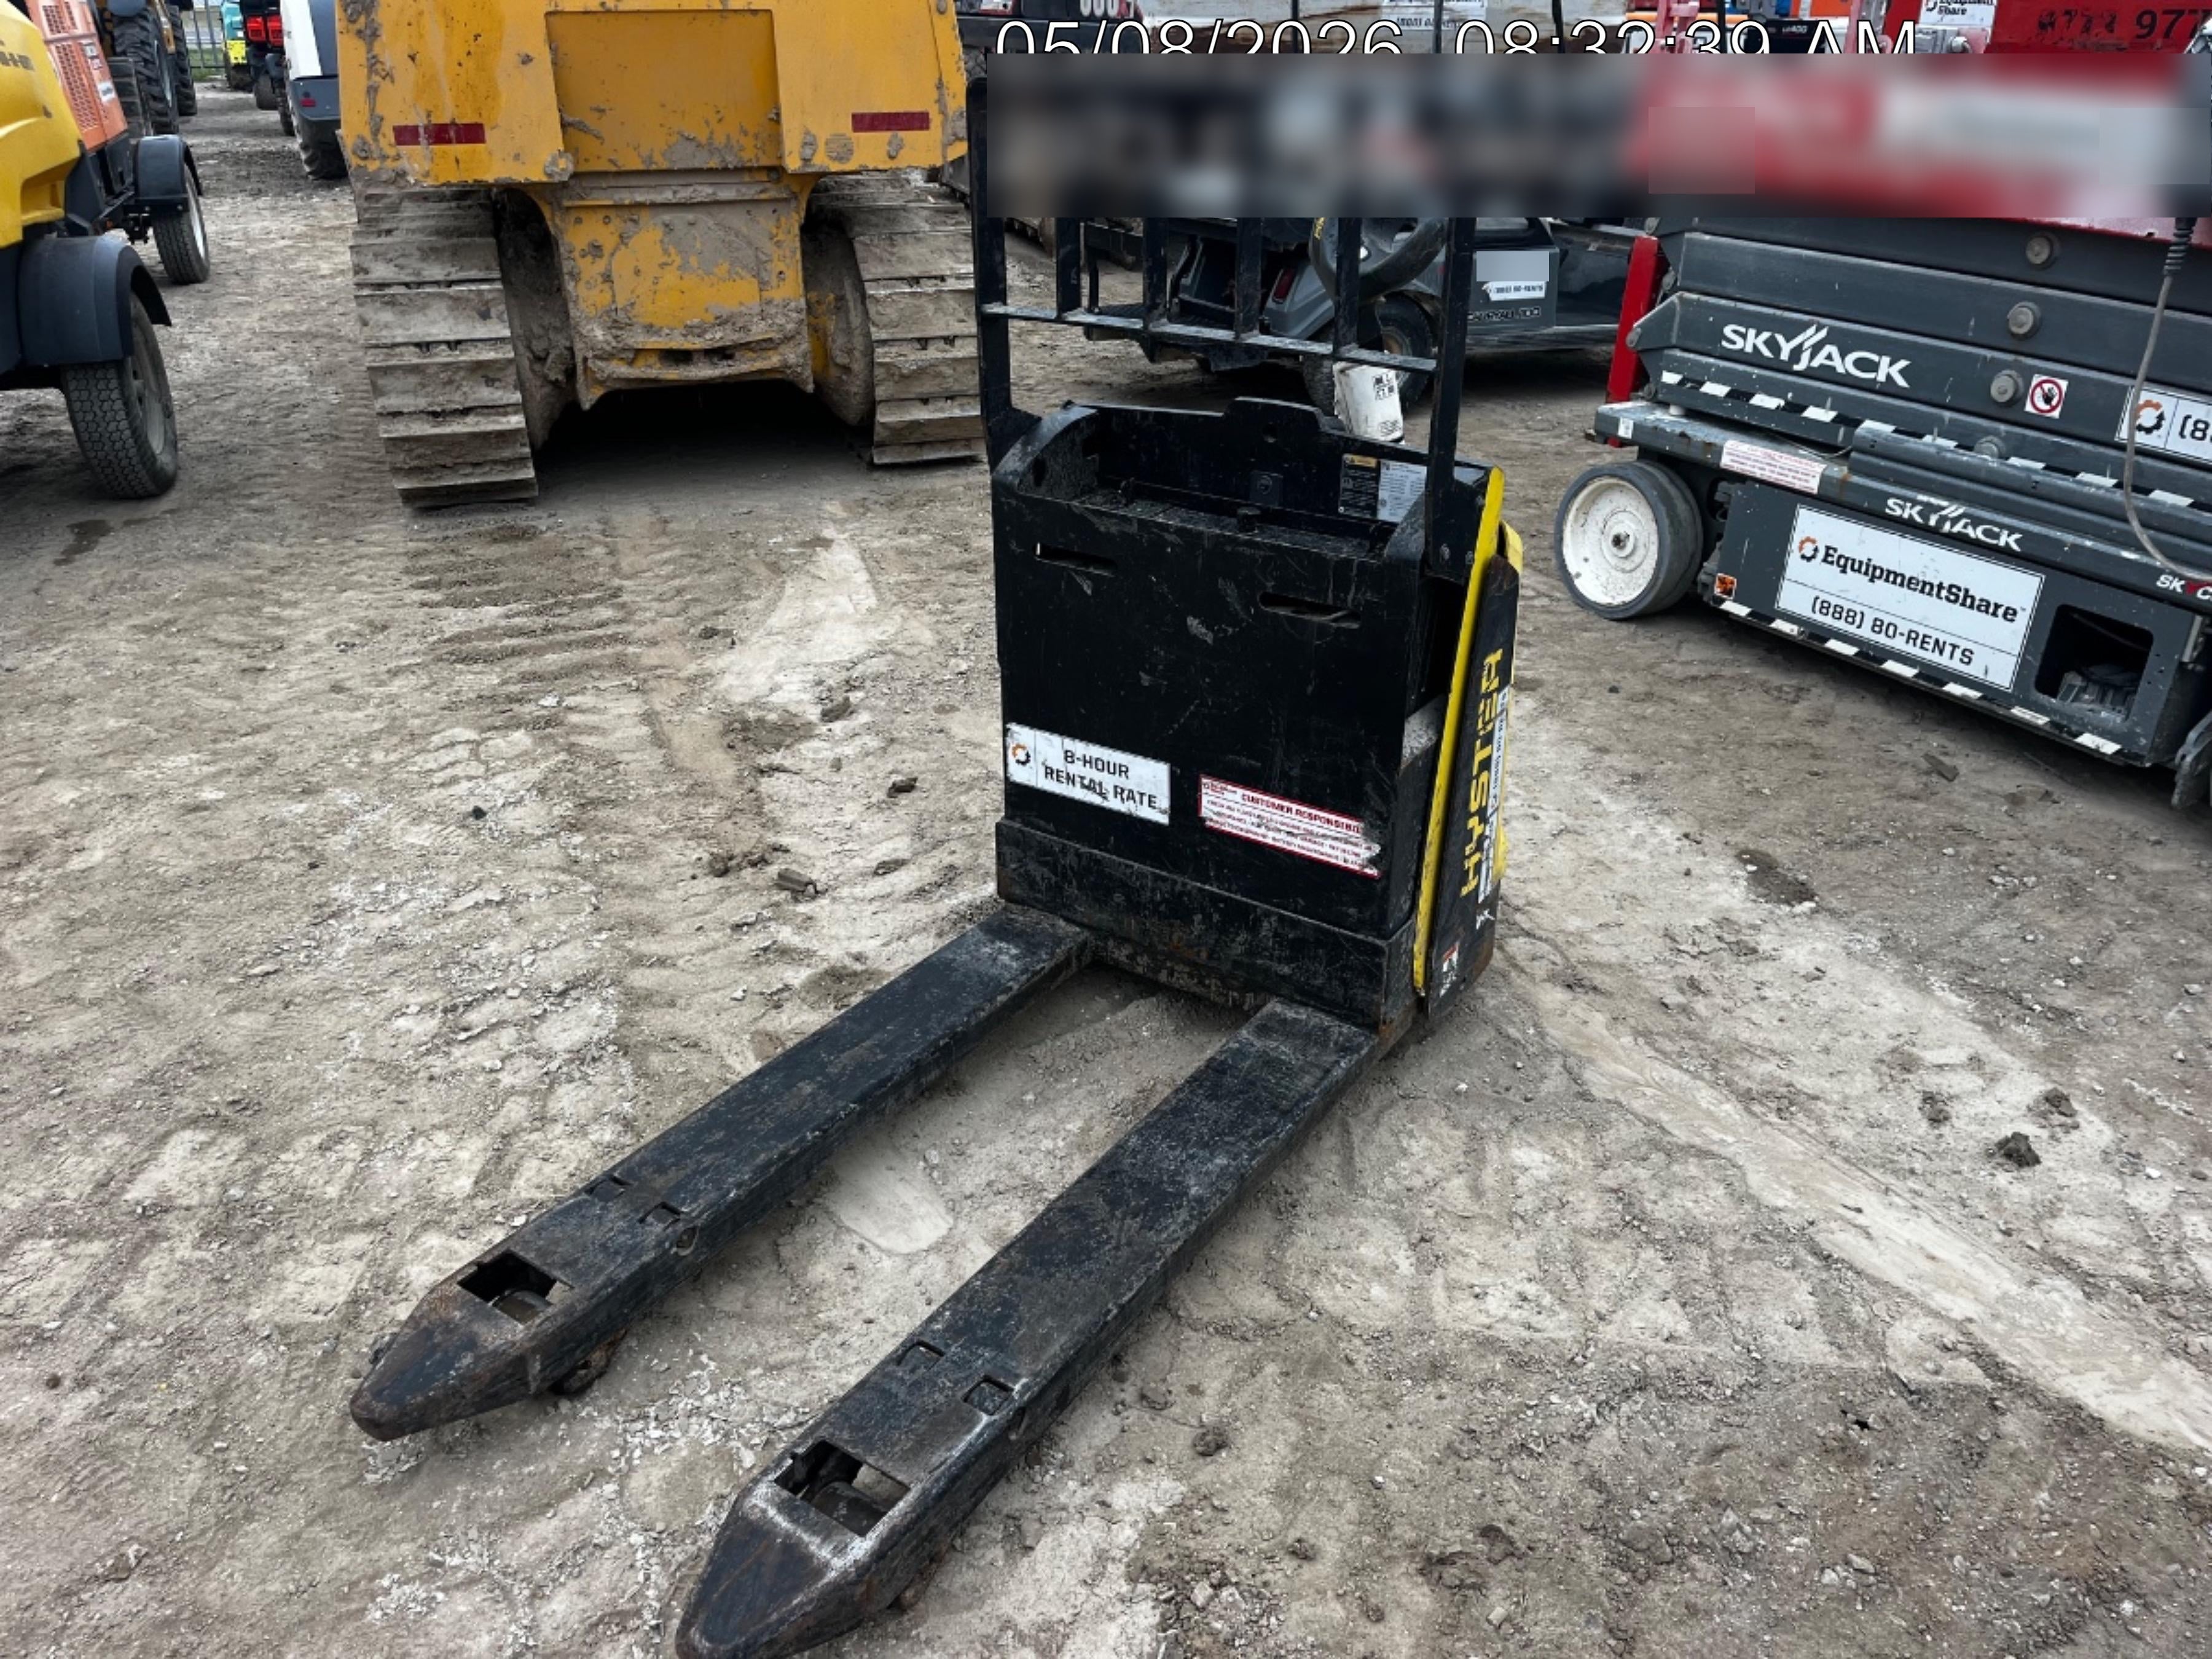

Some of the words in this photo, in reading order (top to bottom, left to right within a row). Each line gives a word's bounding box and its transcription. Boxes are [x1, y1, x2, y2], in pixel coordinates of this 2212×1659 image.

[1721, 323, 1912, 388] SKYJACK
[2179, 414, 2212, 444] (8
[1885, 494, 2023, 552] SKYJACK
[1821, 544, 2018, 623] EquipmentShare
[1811, 595, 1865, 629] (888)
[1870, 616, 1976, 667] 80-RENTS
[1045, 765, 1107, 797] RENTAL
[1113, 784, 1157, 809] RATE
[1064, 749, 1129, 780] 8-HOUR
[1460, 648, 1503, 898] HYSTER
